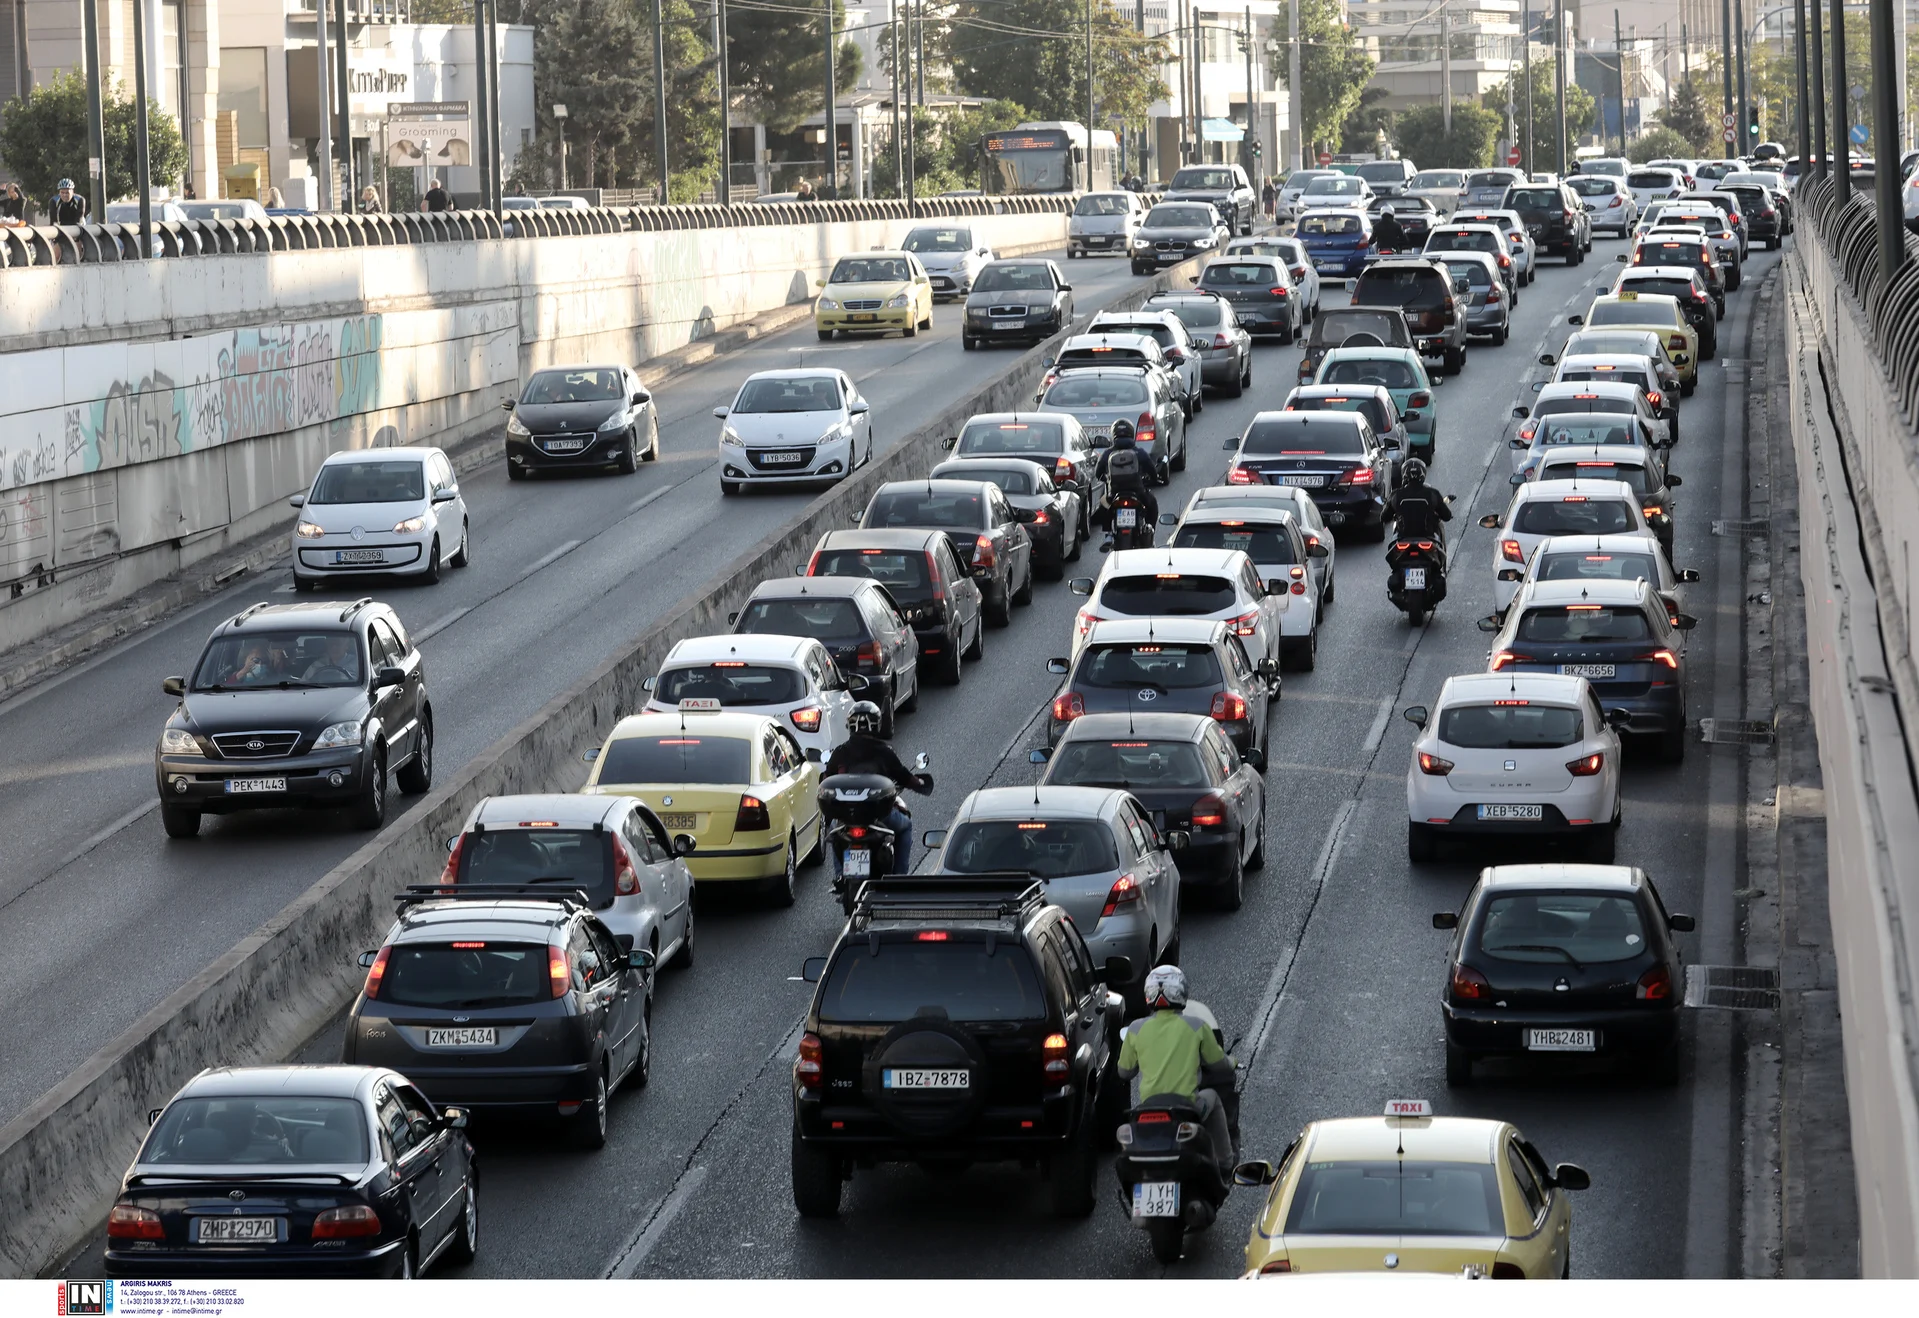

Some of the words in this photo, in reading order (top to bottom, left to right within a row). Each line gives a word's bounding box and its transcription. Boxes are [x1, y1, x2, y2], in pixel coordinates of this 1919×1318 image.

[439, 104, 467, 112] ΦΑΡΜΑΚΑ
[399, 127, 458, 138] Grooming
[1392, 1103, 1422, 1113] TAXI
[1146, 1201, 1175, 1214] 387
